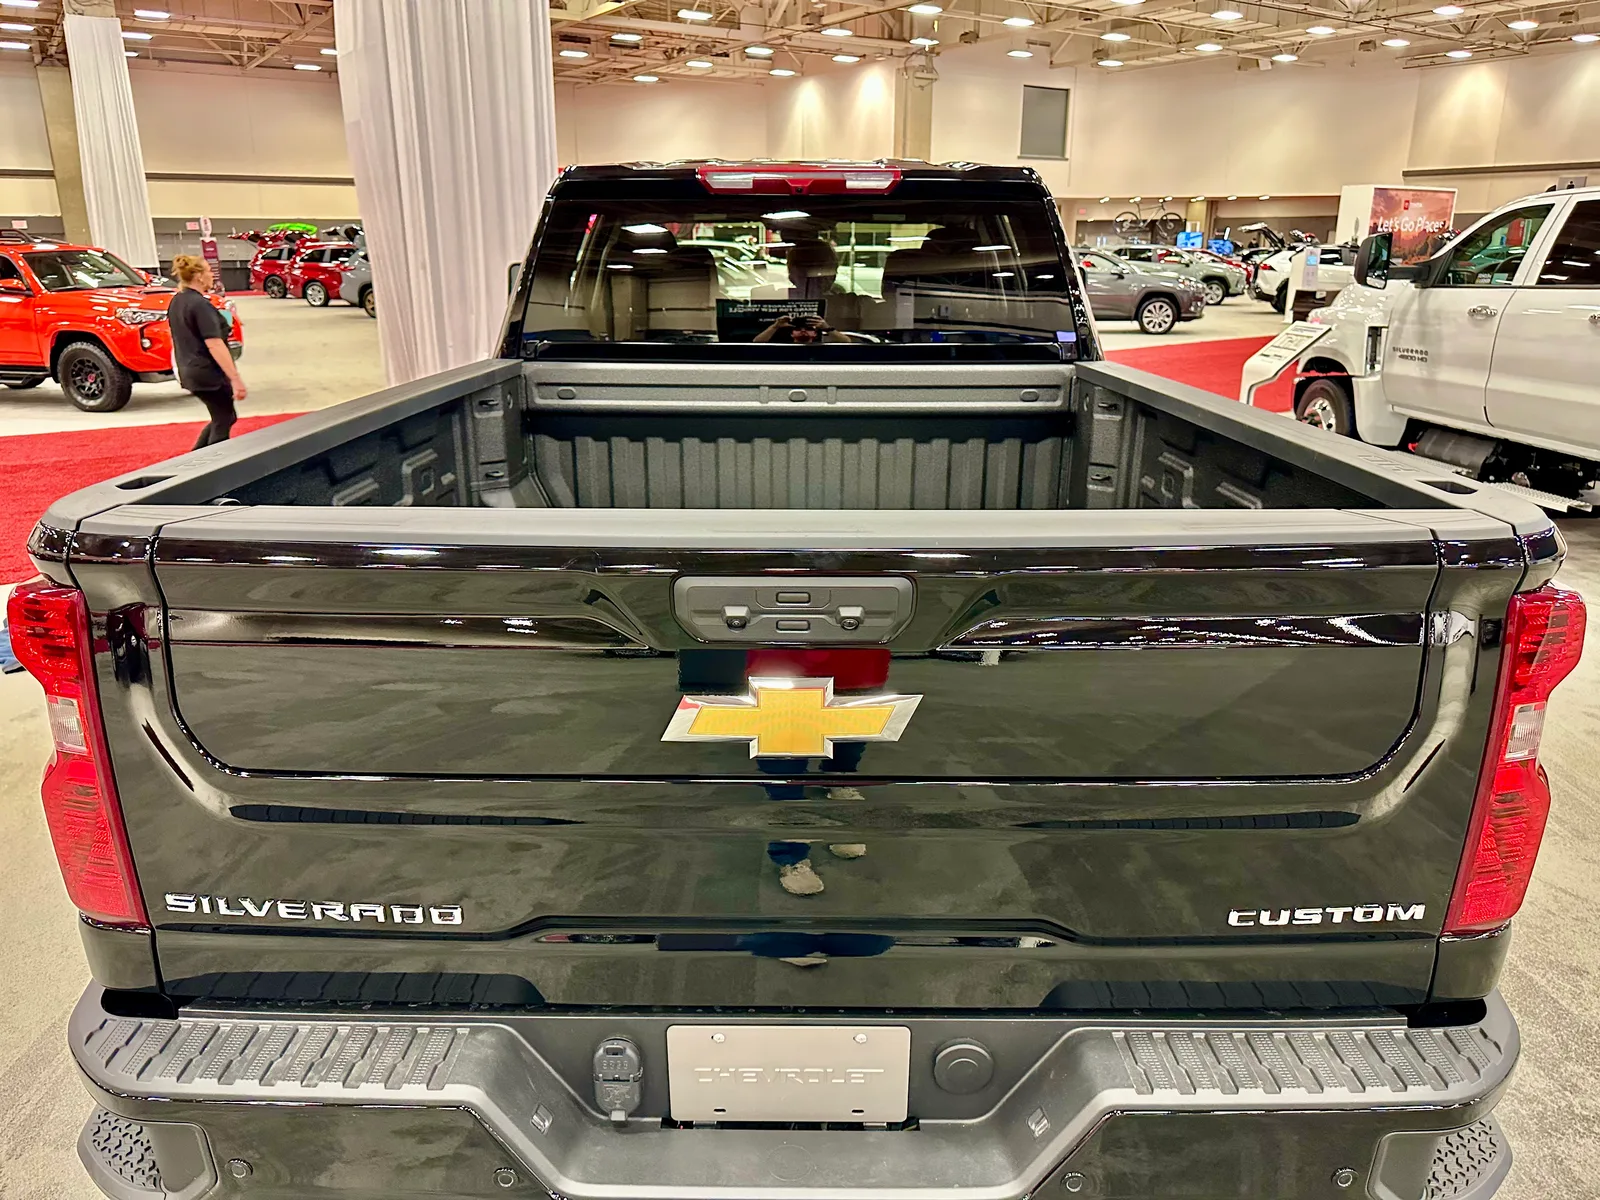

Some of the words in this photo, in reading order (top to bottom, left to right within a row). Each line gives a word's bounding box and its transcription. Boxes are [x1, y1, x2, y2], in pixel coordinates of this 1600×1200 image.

[1377, 216, 1400, 232] Let's
[1401, 216, 1415, 232] Go
[165, 892, 465, 925] SILVERADO
[1228, 903, 1426, 927] CUSTOM
[694, 1067, 884, 1084] CHEVROLET
